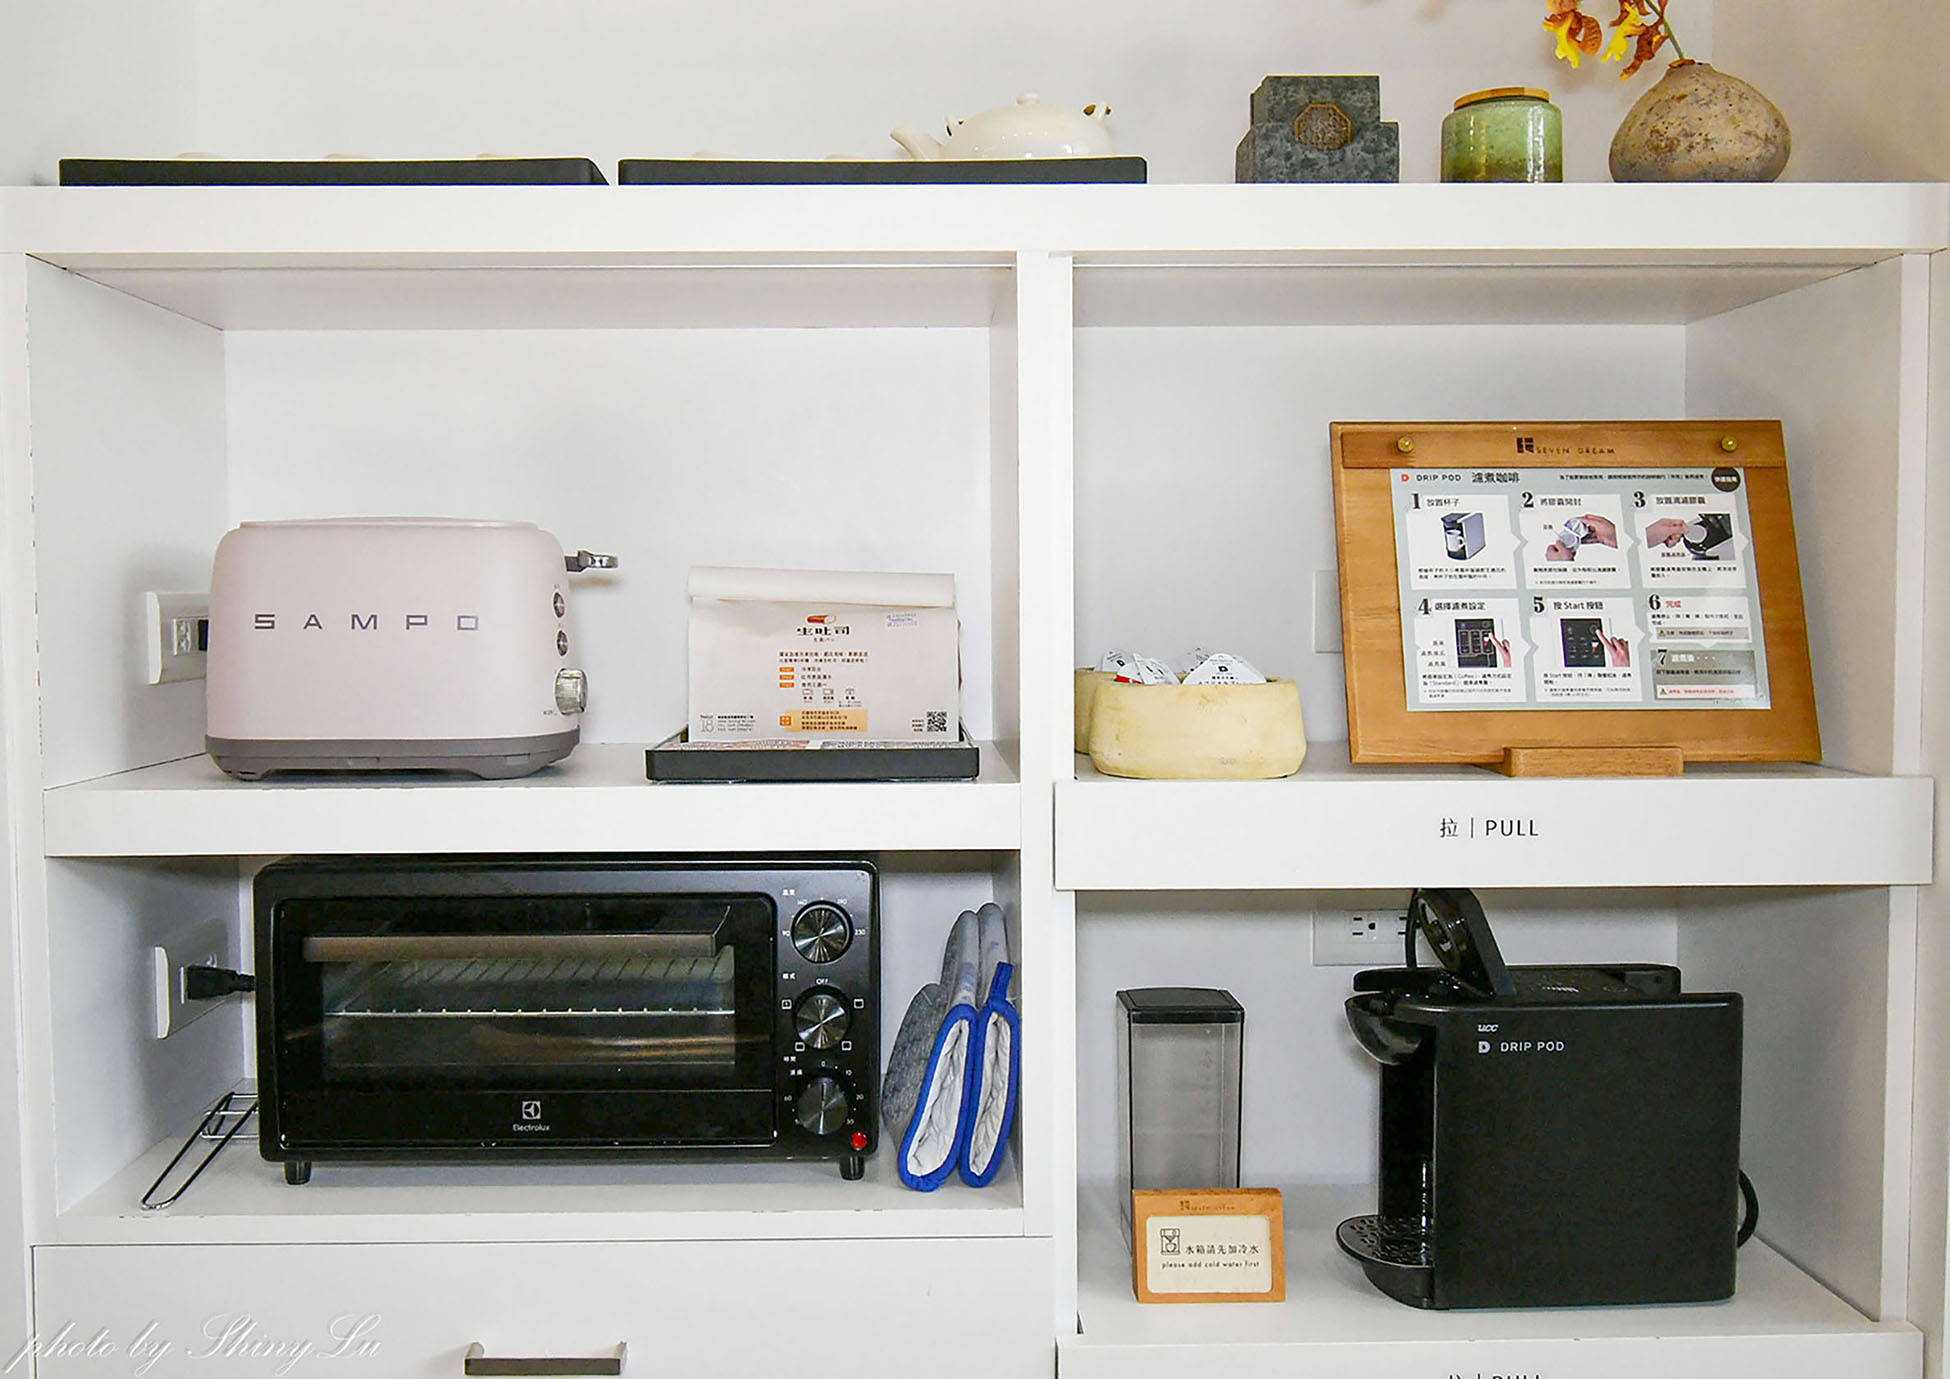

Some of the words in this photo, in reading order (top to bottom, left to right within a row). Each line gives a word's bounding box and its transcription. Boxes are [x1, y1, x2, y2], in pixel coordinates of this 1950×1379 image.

[1416, 474, 1438, 482] DRIP
[1441, 474, 1462, 482] POD
[1472, 472, 1520, 484] 濾煮咖啡
[1411, 493, 1421, 510] 1
[1522, 491, 1534, 508] 2
[1633, 491, 1646, 508] 3
[1418, 598, 1432, 615] 4
[1533, 596, 1545, 613] 5
[1564, 602, 1585, 610] Start
[1648, 594, 1661, 611] 6
[254, 613, 479, 631] SAMPO
[796, 626, 850, 636] 生吐司
[1657, 649, 1667, 665] 7
[1439, 817, 1459, 838] 拉
[1485, 819, 1539, 837] PULL
[1500, 1042, 1532, 1053] DRIP
[1537, 1041, 1565, 1052] POD
[512, 1123, 550, 1132] Electrolux
[1185, 1244, 1260, 1255] 水箱請先加冷水
[1161, 1260, 1185, 1269] please
[1188, 1260, 1202, 1268] add
[1204, 1260, 1220, 1268] cold
[1245, 1259, 1260, 1267] first
